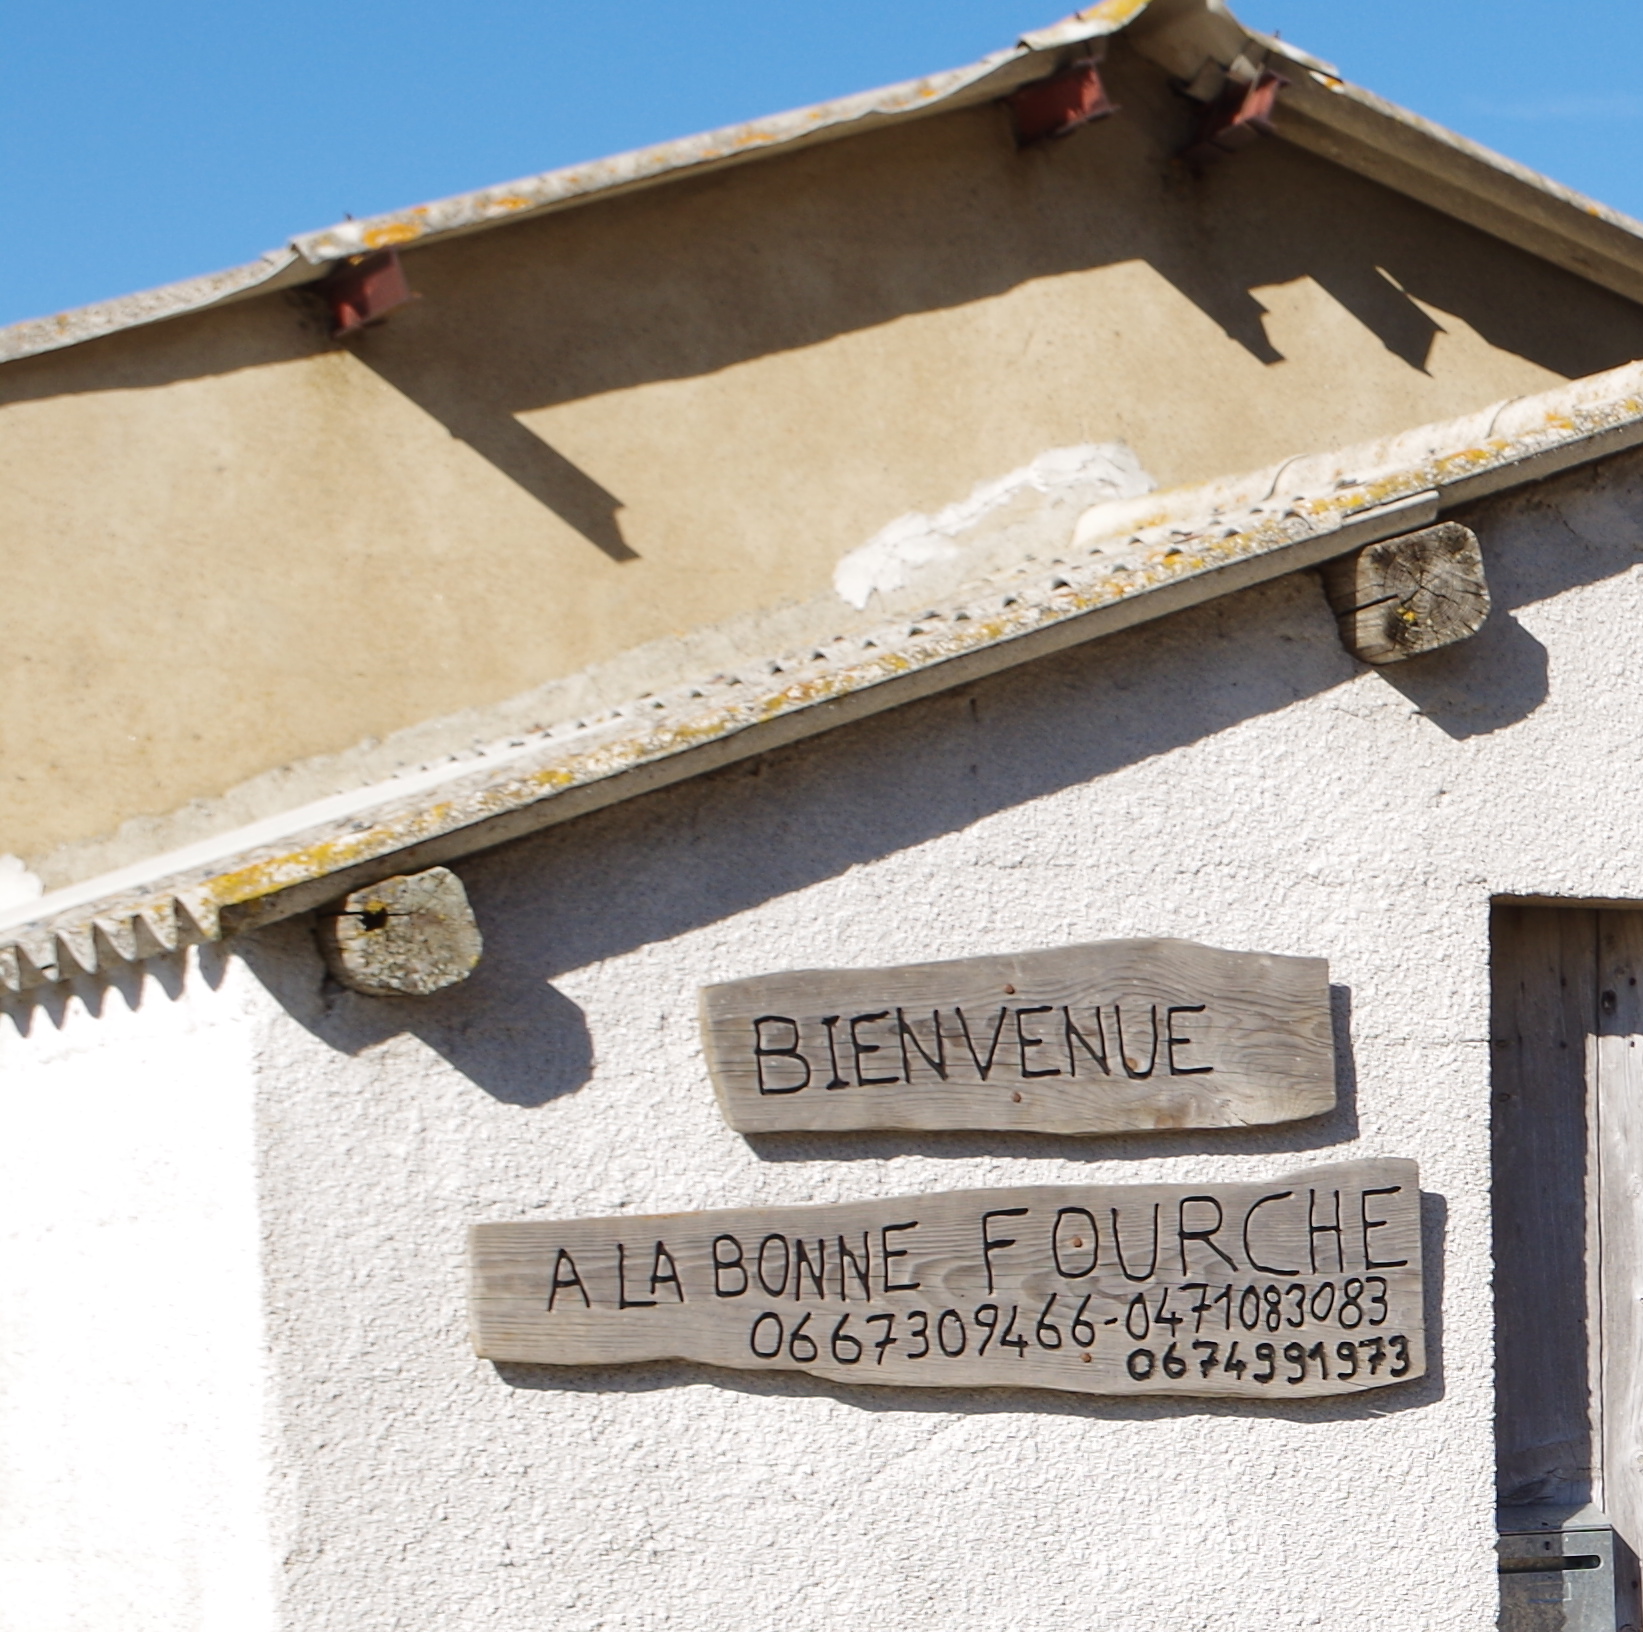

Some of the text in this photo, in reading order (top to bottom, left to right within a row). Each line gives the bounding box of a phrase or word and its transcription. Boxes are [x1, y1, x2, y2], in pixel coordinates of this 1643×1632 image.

[751, 1003, 1215, 1096] BIENVENUE
[547, 1247, 591, 1312] A
[617, 1240, 685, 1310] LA
[711, 1220, 922, 1303] BONNE
[1126, 1332, 1411, 1383] 0674991973
